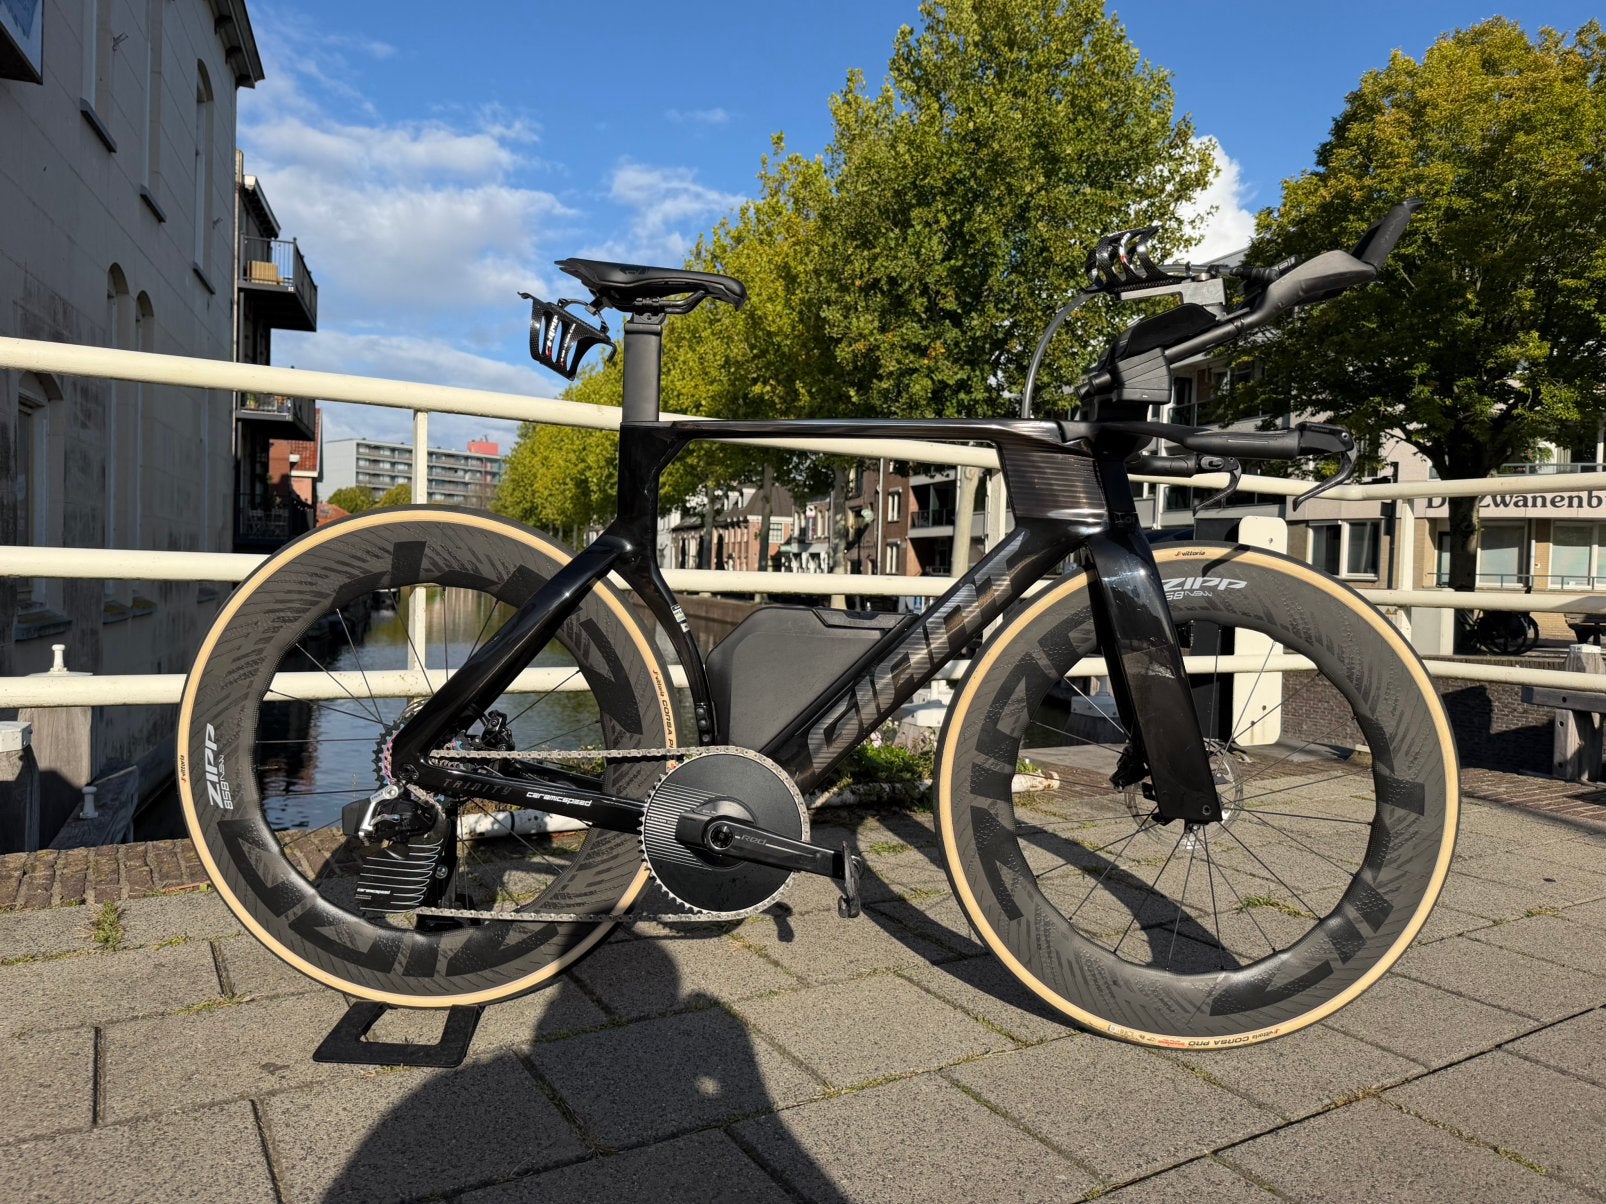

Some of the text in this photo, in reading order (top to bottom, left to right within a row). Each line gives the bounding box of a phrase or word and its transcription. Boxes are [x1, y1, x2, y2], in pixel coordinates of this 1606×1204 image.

[1478, 490, 1606, 509] wanenb
[1161, 577, 1248, 591] ZIPP
[808, 531, 1026, 775] GIANT
[662, 699, 674, 736] CORSA
[205, 722, 224, 809] ZIPP
[442, 778, 513, 796] TRINITY
[525, 791, 593, 807] ceramicspeed
[1213, 1035, 1250, 1046] CORSA
